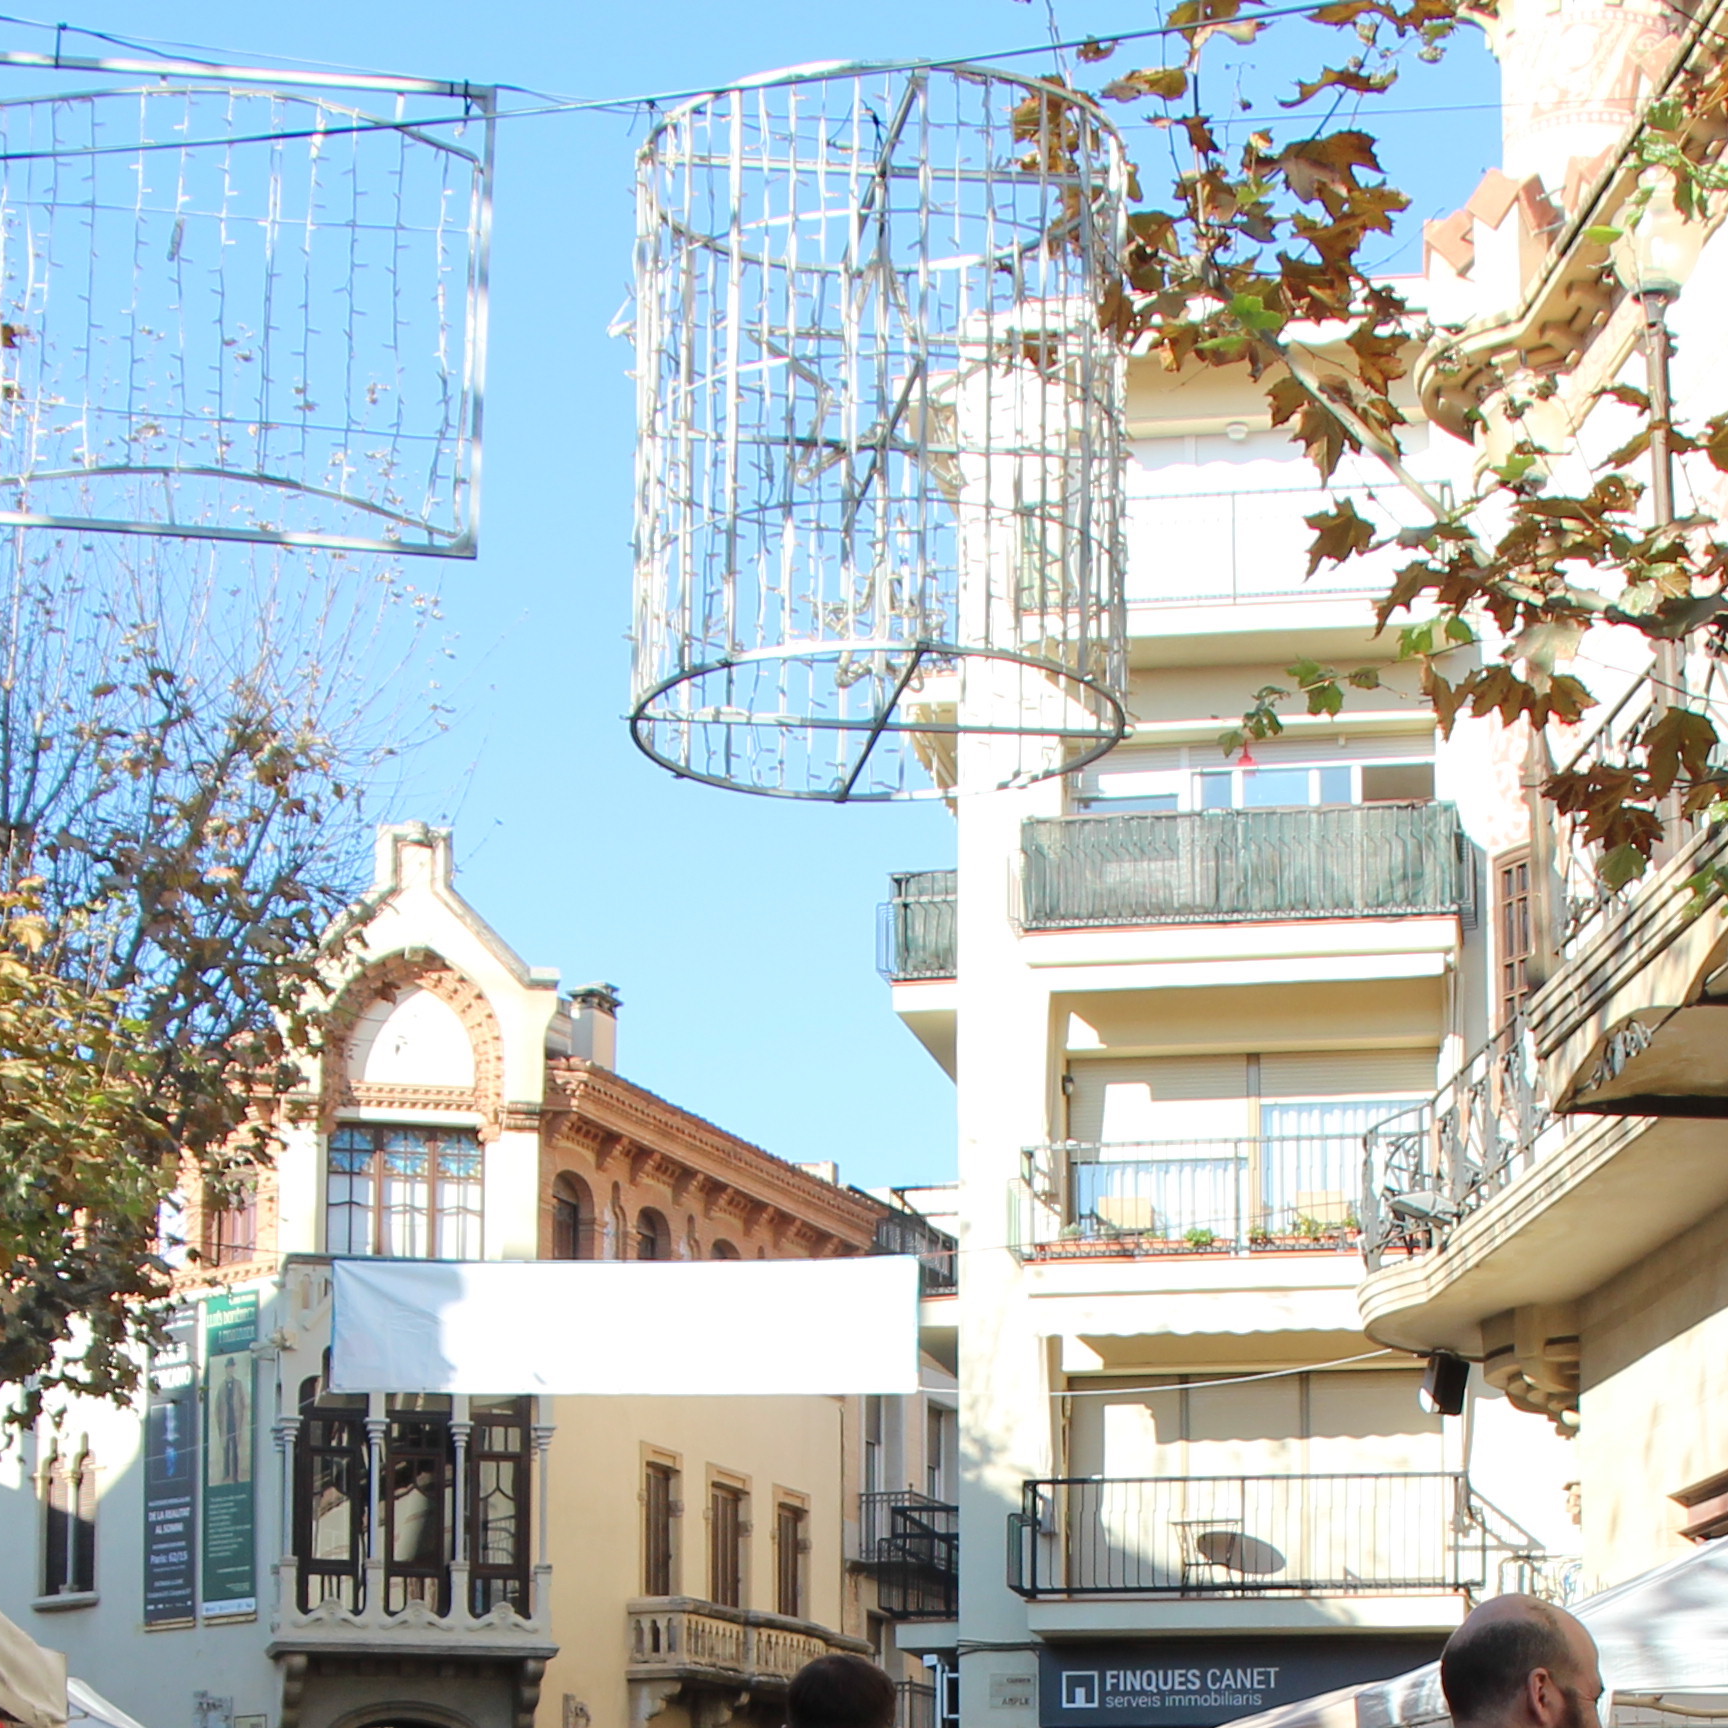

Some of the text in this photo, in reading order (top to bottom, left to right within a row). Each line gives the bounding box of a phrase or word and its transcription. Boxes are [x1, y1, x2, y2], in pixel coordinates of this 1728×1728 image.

[1105, 1667, 1279, 1692] FINQUES CANET
[1105, 1690, 1262, 1708] serveis immobiliaris
